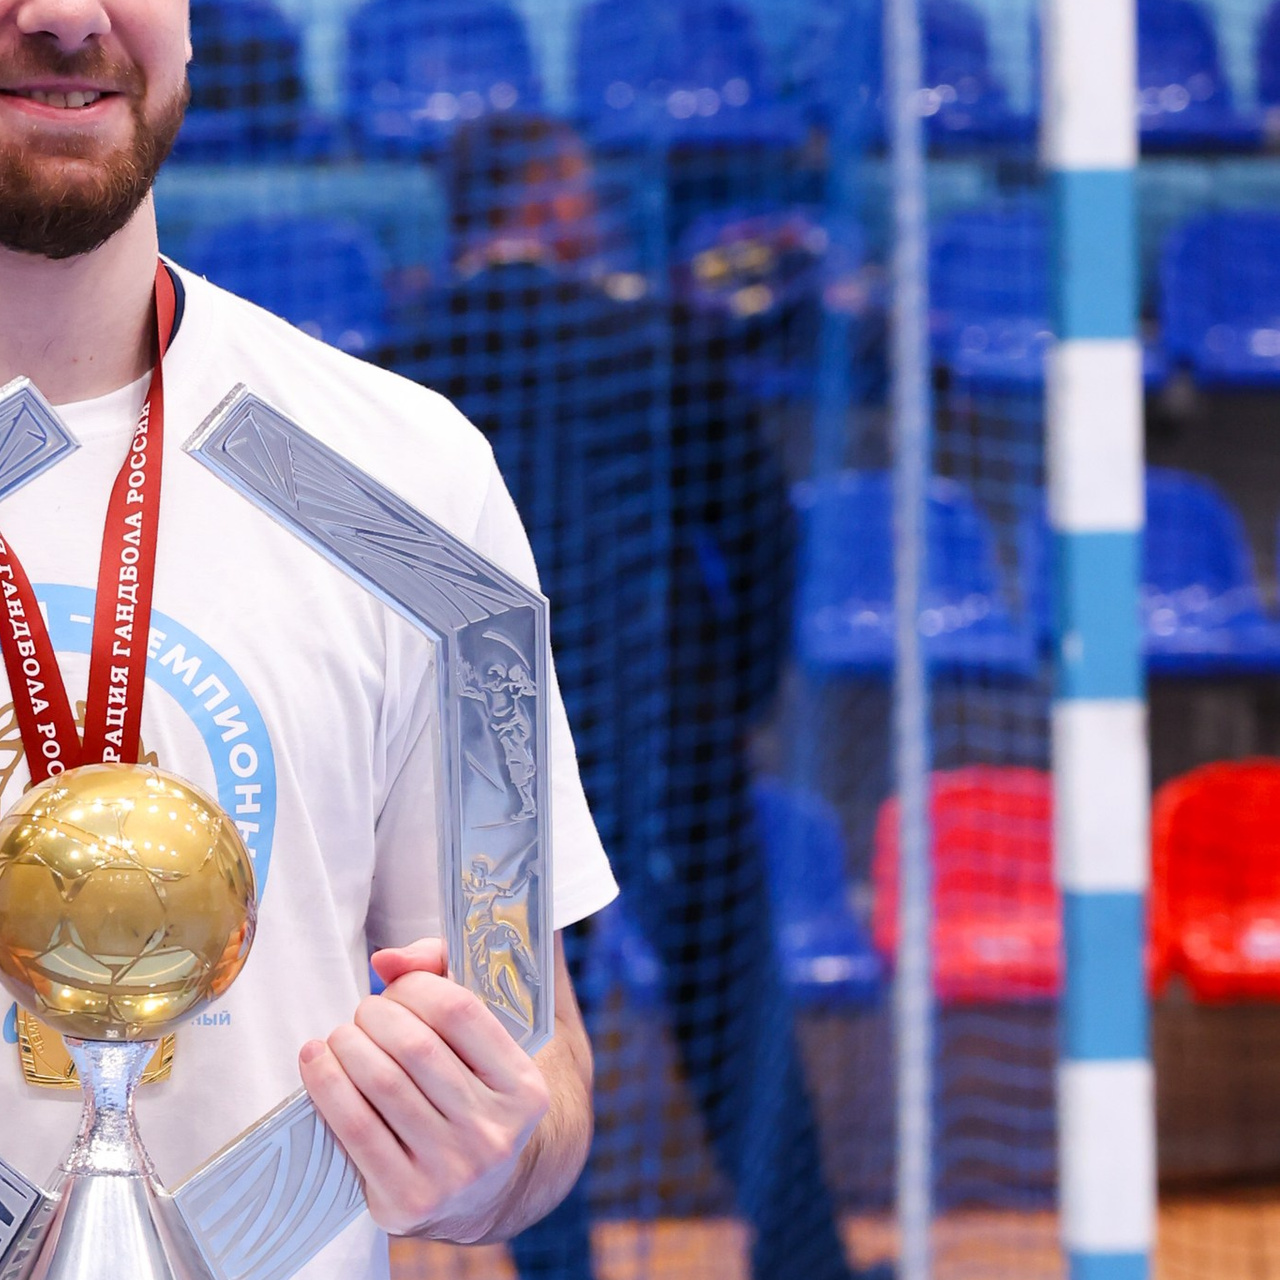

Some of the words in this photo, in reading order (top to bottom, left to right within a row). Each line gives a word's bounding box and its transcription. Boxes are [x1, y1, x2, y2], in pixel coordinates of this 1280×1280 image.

[112, 511, 144, 658] ГАНДБОЛА
[36, 721, 66, 778] РОС
[102, 665, 130, 764] РАЦИЯ
[147, 626, 262, 859] ЕМПИОНЫ
